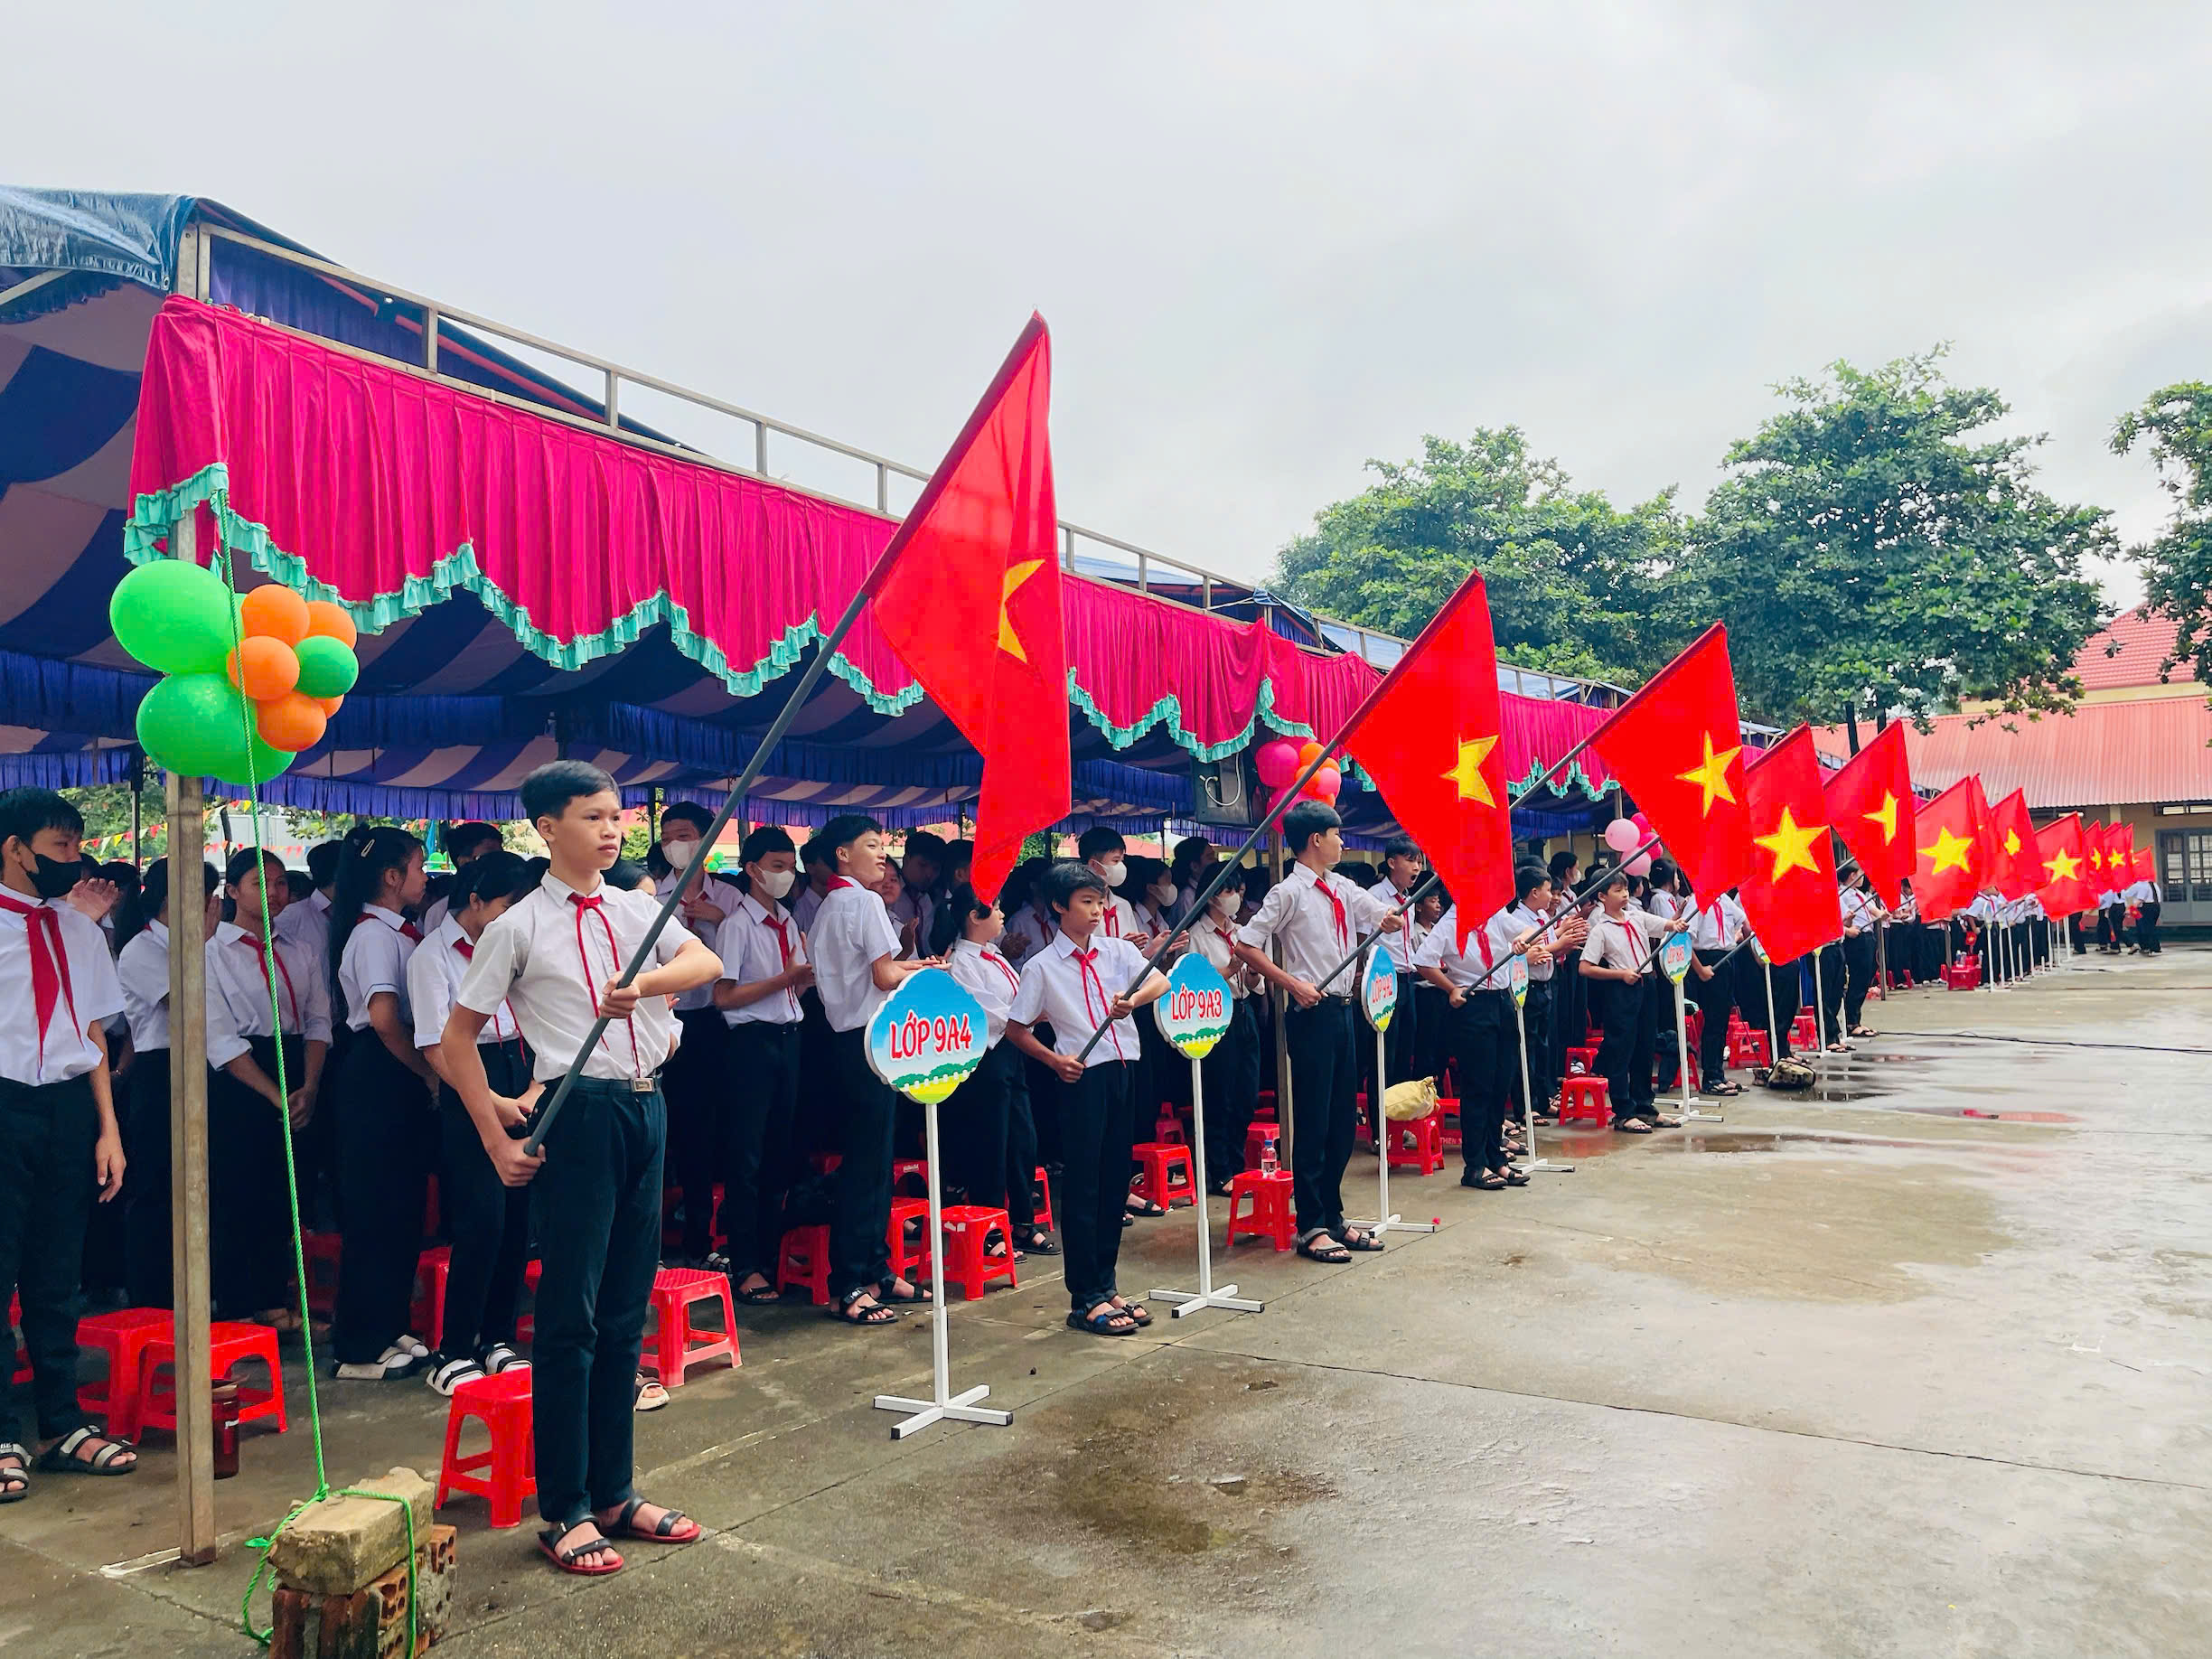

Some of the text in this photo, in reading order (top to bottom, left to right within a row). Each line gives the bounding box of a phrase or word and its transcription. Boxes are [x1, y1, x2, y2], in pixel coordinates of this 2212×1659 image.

[1172, 984, 1223, 1020] LỚP 9A3
[890, 1010, 972, 1059] LỚP 9A4
